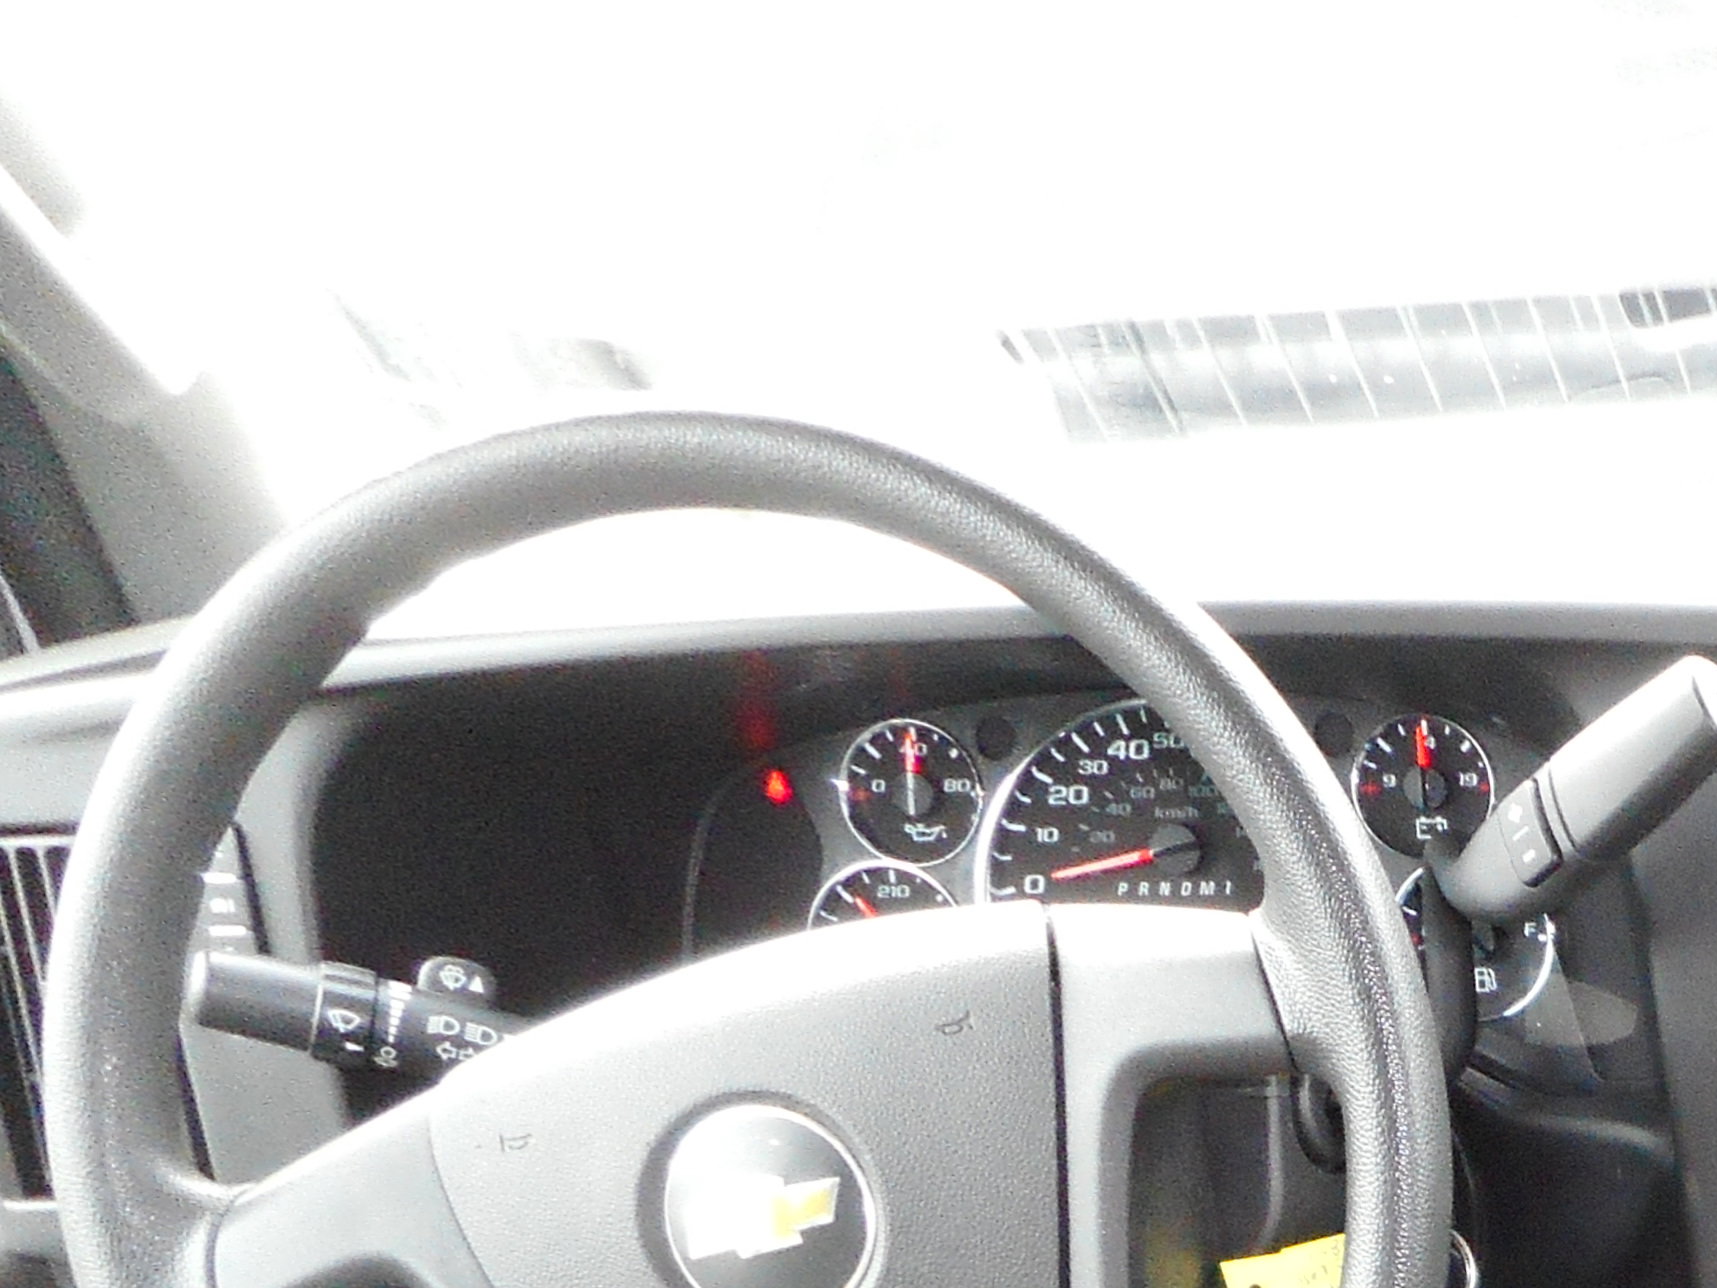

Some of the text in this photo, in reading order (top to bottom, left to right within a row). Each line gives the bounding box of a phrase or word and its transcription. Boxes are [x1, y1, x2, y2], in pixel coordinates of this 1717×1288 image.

[1107, 739, 1149, 760] 40
[1078, 760, 1109, 775] 30
[871, 779, 886, 792] 0
[943, 779, 971, 792] 80
[1383, 774, 1396, 788] 9
[1459, 772, 1478, 787] 19
[1048, 785, 1088, 805] 20
[1130, 787, 1155, 799] 60
[1154, 806, 1200, 819] km/h
[1036, 827, 1058, 842] 10
[877, 885, 910, 898] 210
[1024, 874, 1044, 894] 0
[1524, 922, 1536, 937] F
